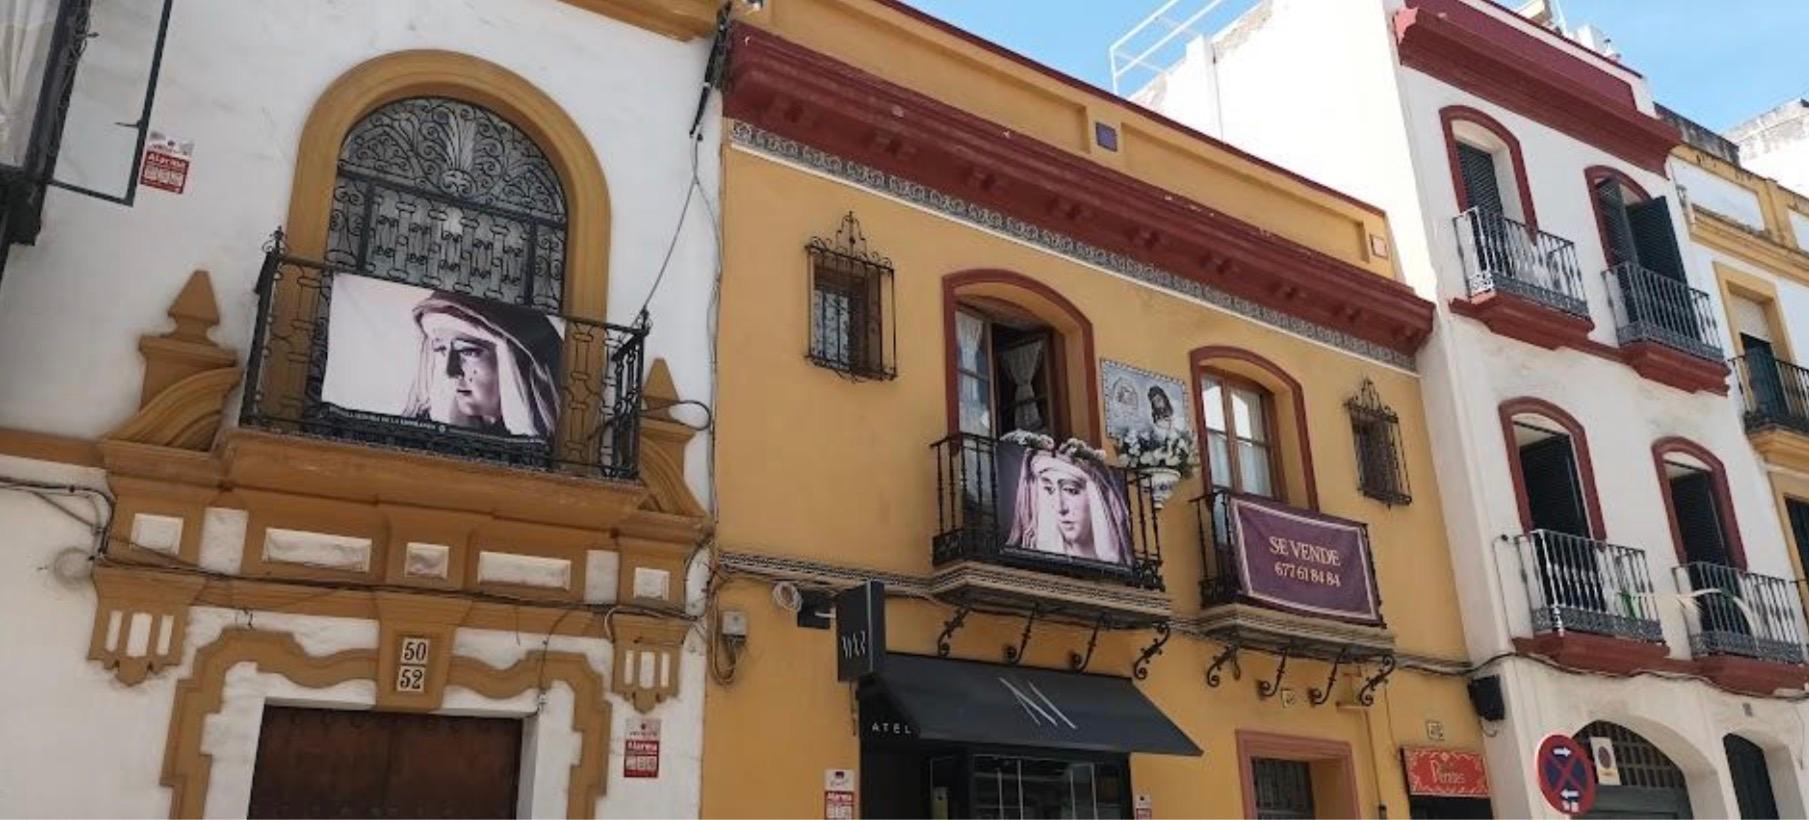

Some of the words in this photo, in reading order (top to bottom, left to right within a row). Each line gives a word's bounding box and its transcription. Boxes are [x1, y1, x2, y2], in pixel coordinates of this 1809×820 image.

[1268, 536, 1289, 556] SE
[1289, 540, 1341, 567] VENDE
[1274, 561, 1296, 578] 677
[1310, 568, 1325, 584] 84
[1326, 571, 1341, 587] 84
[404, 642, 426, 660] 50
[400, 669, 423, 689] 52
